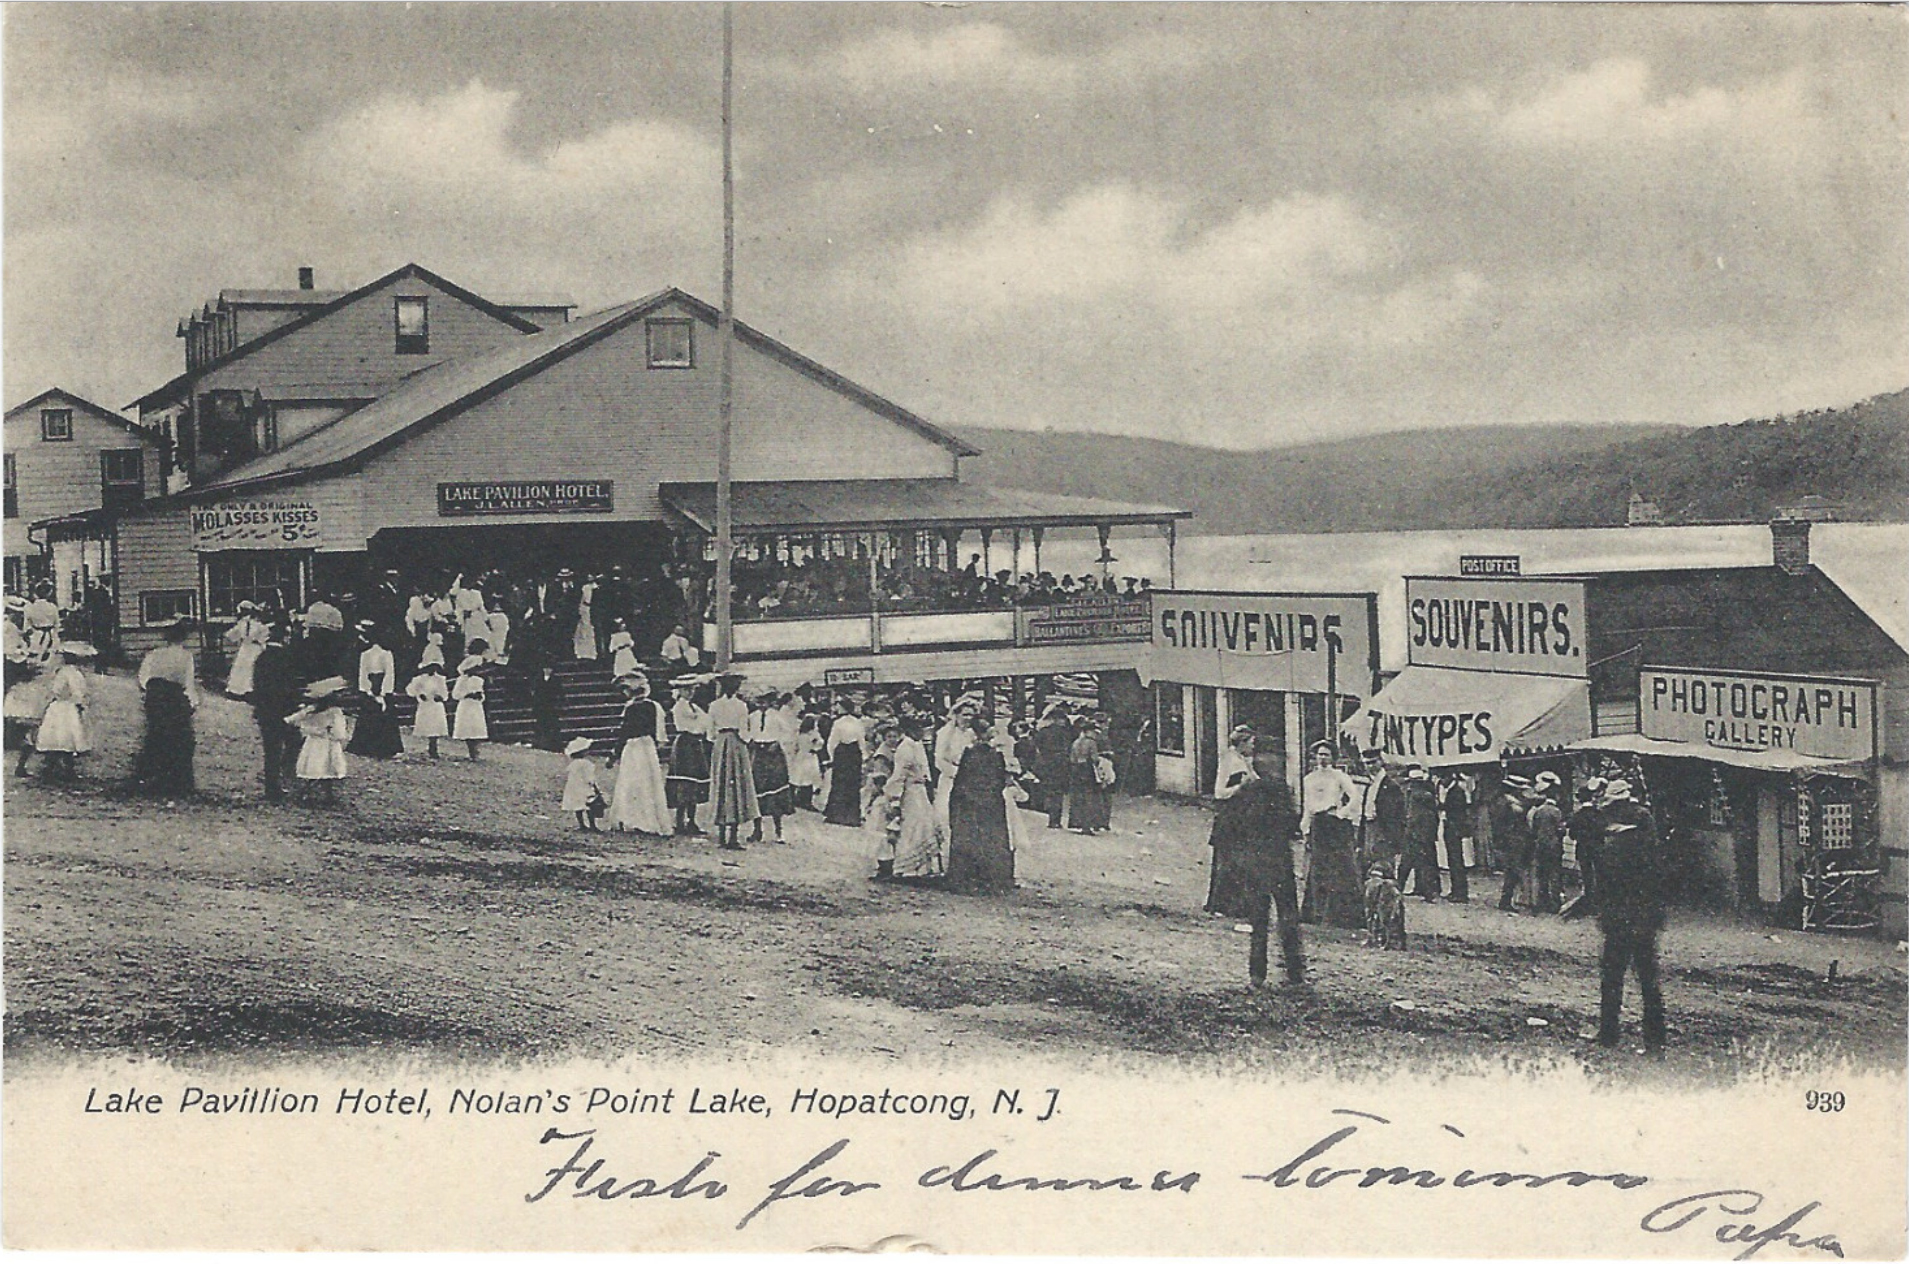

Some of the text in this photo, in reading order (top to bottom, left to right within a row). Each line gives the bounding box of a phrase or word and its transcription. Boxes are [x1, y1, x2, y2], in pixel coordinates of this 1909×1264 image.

[261, 502, 313, 510] ORIGINAL
[445, 487, 481, 500] LAKE
[485, 485, 550, 499] PAVILION
[192, 510, 319, 534] MOLASSES KISSES
[1462, 559, 1518, 573] POST OFFICE
[1162, 609, 1343, 654] SOUVENIRS
[1411, 598, 1579, 657] SOUVENIRS.
[1653, 677, 1857, 729] PHOTOGRAPH
[1367, 709, 1493, 756] TINTYPES
[1705, 720, 1797, 748] GALLERY
[737, 1138, 880, 1231] for
